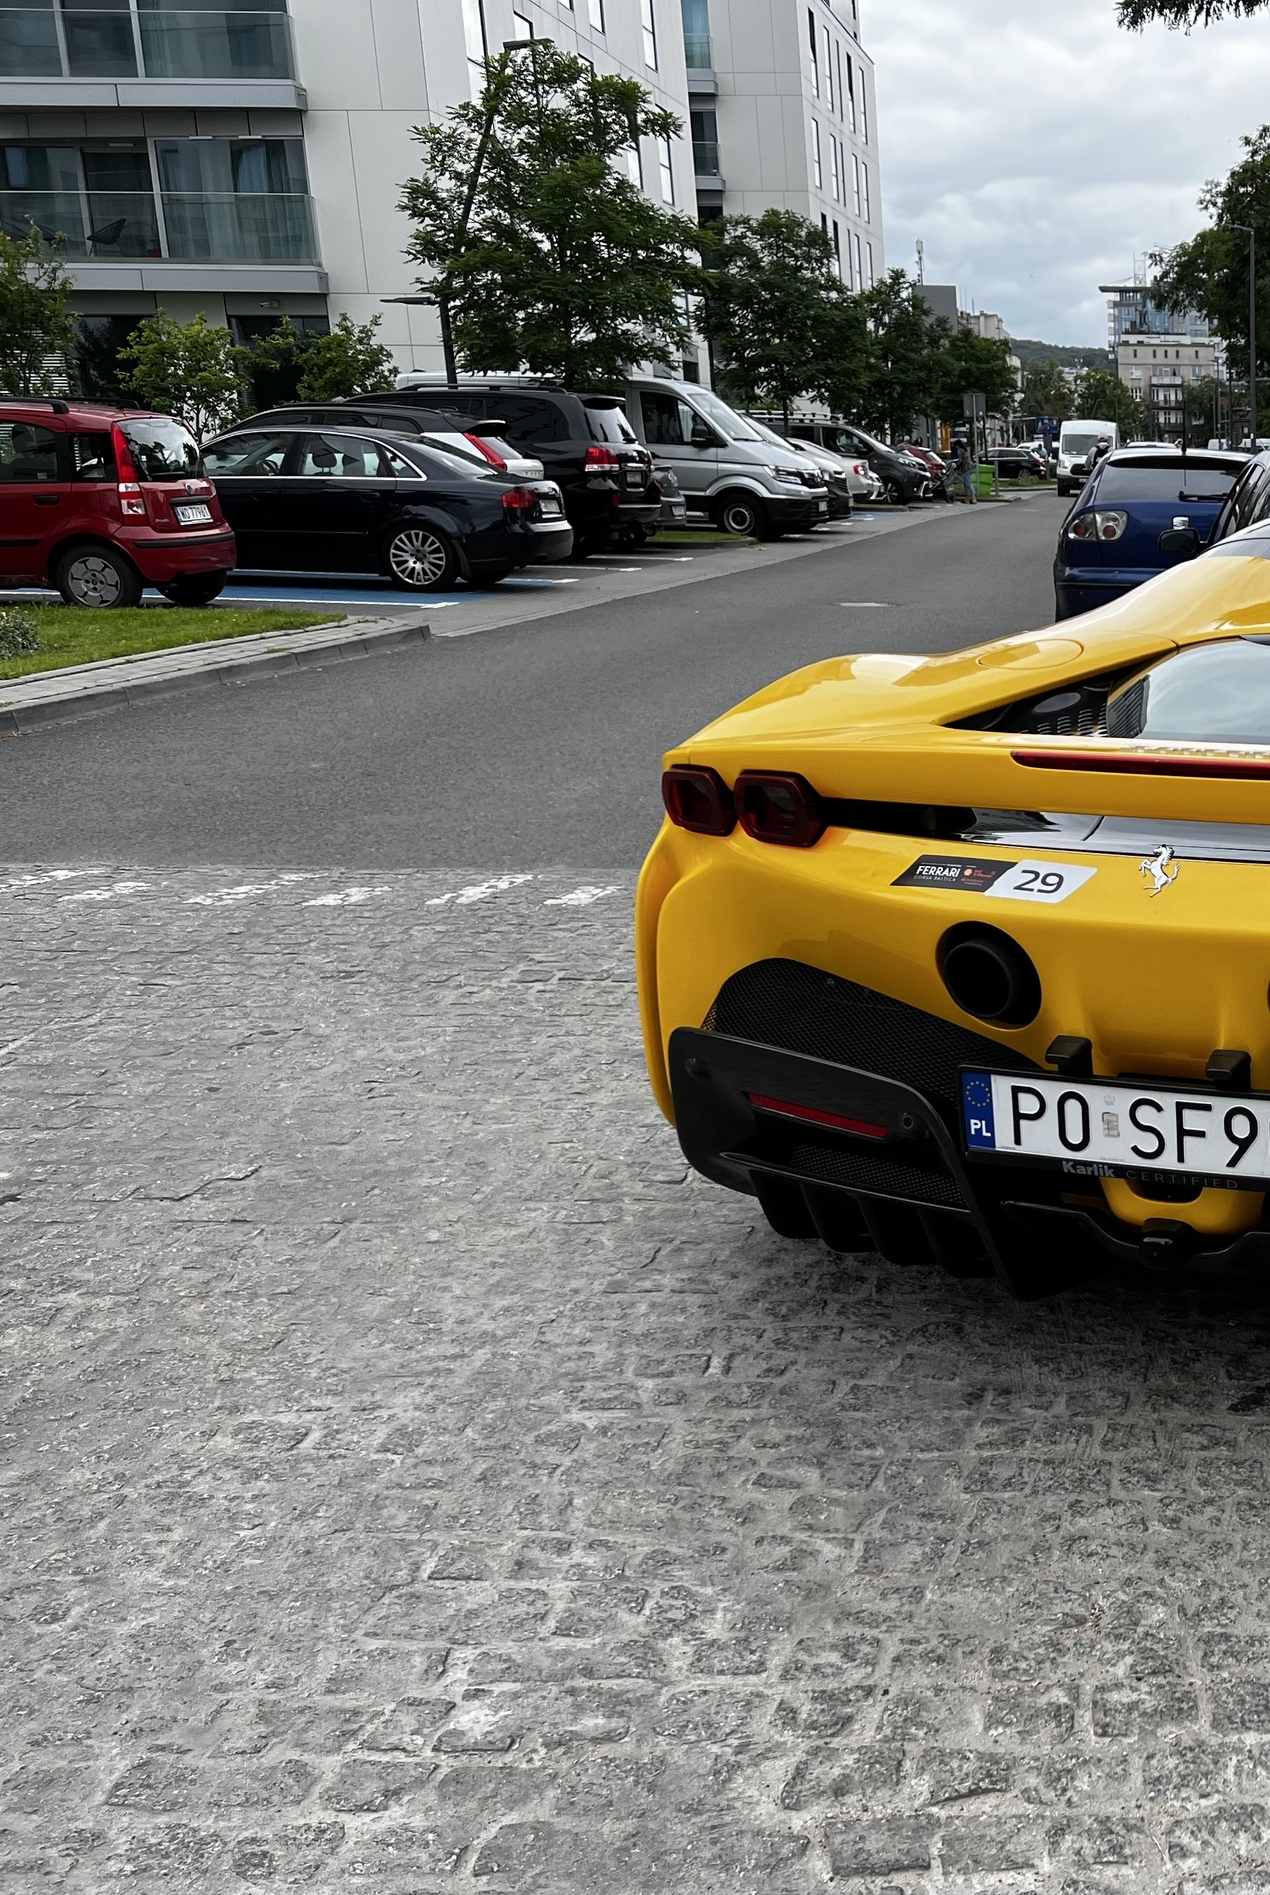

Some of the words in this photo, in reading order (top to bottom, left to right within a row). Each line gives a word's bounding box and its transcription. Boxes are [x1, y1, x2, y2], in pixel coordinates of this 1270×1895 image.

[916, 865, 961, 878] FERRARI
[1013, 869, 1064, 894] 29
[970, 1119, 991, 1137] PL
[1062, 1160, 1116, 1178] Karlik
[1125, 1170, 1238, 1189] CERTIFIED
